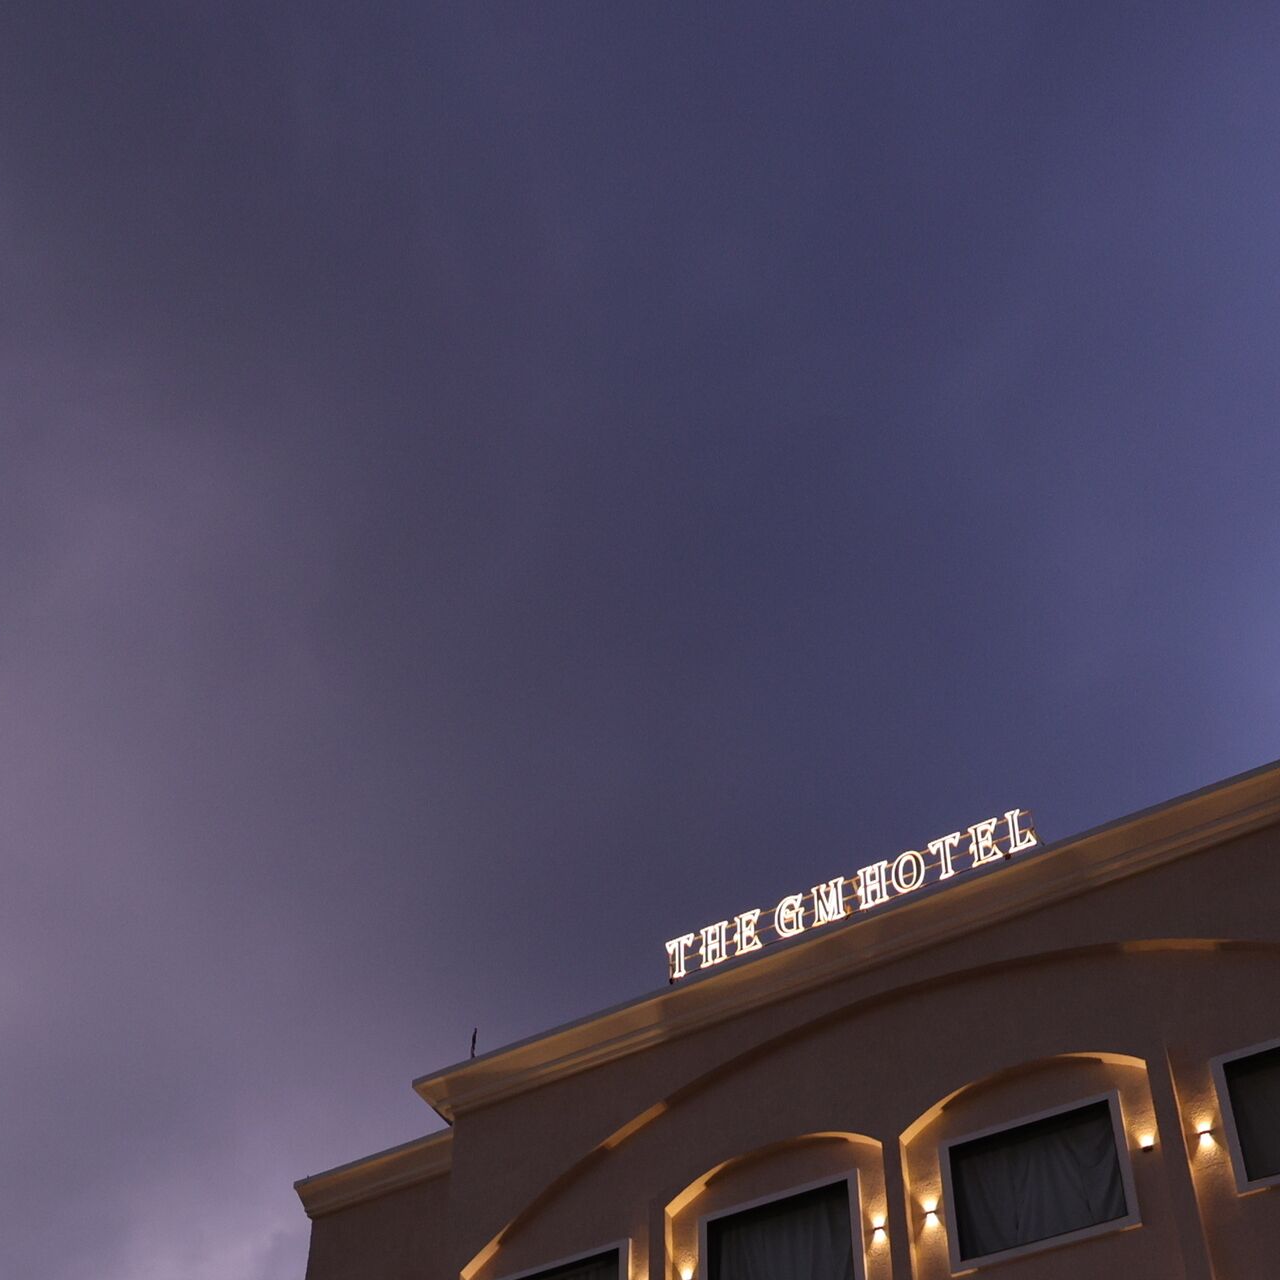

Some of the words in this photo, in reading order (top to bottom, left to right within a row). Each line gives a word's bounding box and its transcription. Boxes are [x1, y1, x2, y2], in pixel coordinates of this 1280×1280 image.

[665, 908, 762, 979] THE
[774, 877, 847, 939] GM
[856, 808, 1038, 911] HOTEL
